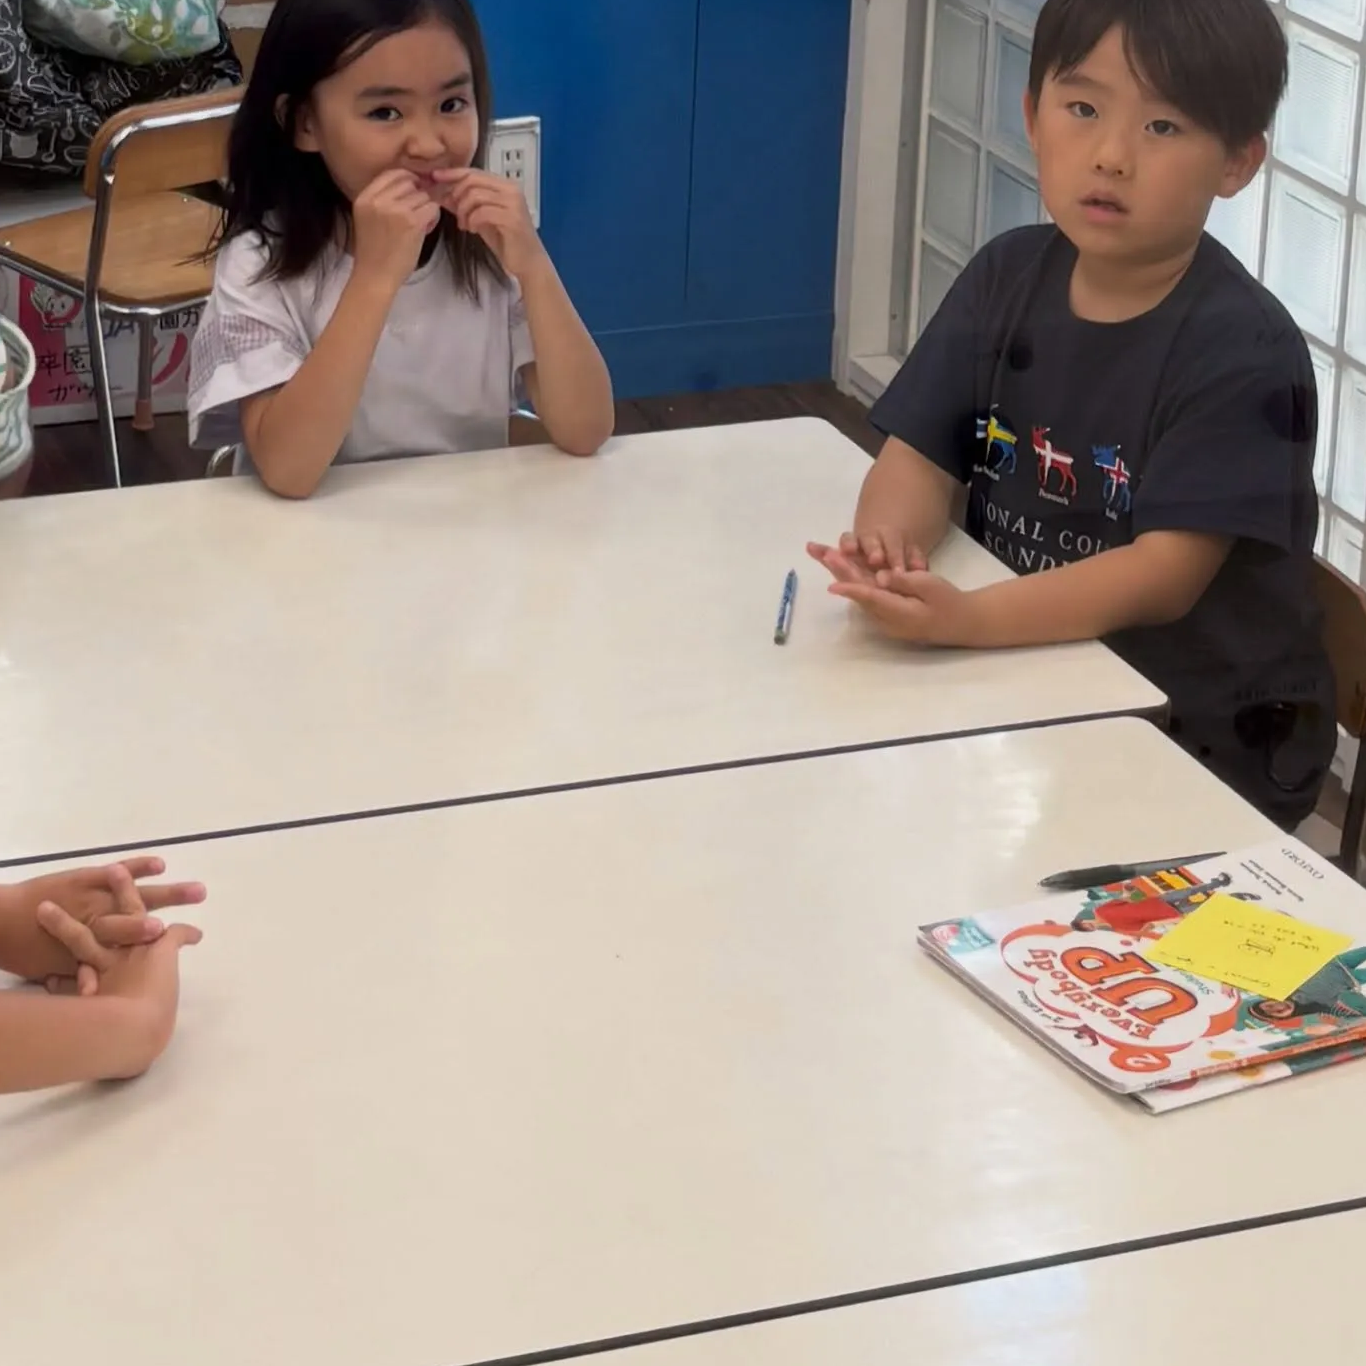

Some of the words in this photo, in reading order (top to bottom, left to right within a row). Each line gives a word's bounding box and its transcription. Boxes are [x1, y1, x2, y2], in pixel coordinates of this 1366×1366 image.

[981, 496, 1044, 542] ONAL
[984, 531, 1067, 572] SCAND
[1023, 948, 1157, 1039] Everybody
